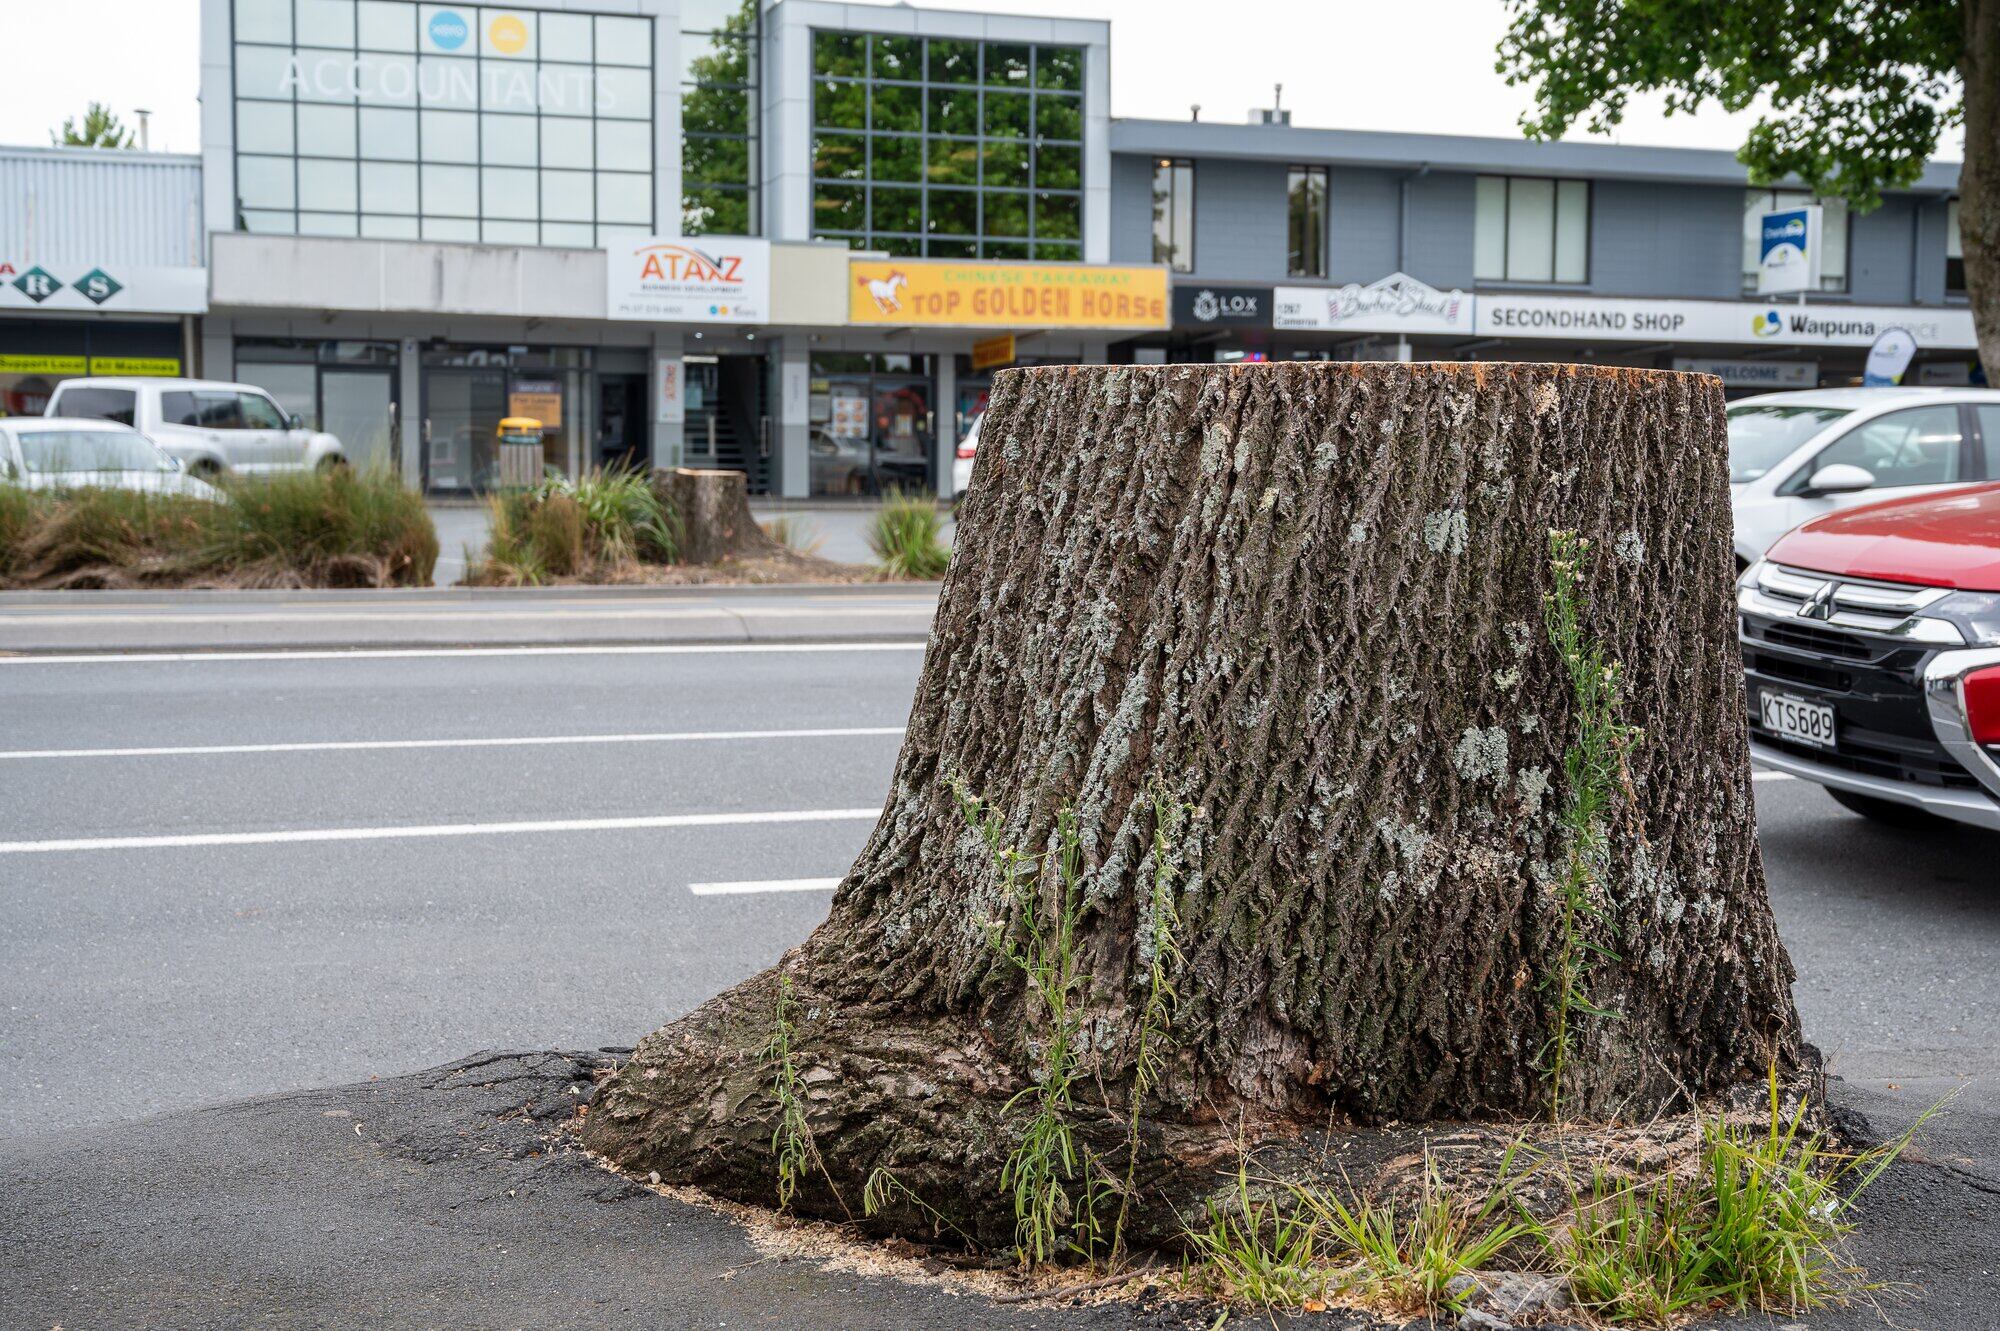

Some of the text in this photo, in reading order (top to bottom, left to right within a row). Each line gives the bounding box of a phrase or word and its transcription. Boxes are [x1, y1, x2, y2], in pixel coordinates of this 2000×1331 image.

[278, 57, 618, 111] ACCOUNTANTS
[943, 270, 1132, 286] CHINESE TAKEAWAY
[912, 287, 1163, 319] TOP GOLDEN HORSE
[1220, 295, 1258, 312] LOX
[1491, 307, 1685, 332] SECONDHAND SHOP
[1789, 314, 1876, 338] Waipuna
[51, 360, 85, 370] Local
[114, 362, 175, 372] Machines
[1711, 364, 1780, 381] WELCOME
[1763, 697, 1833, 740] KTS609
